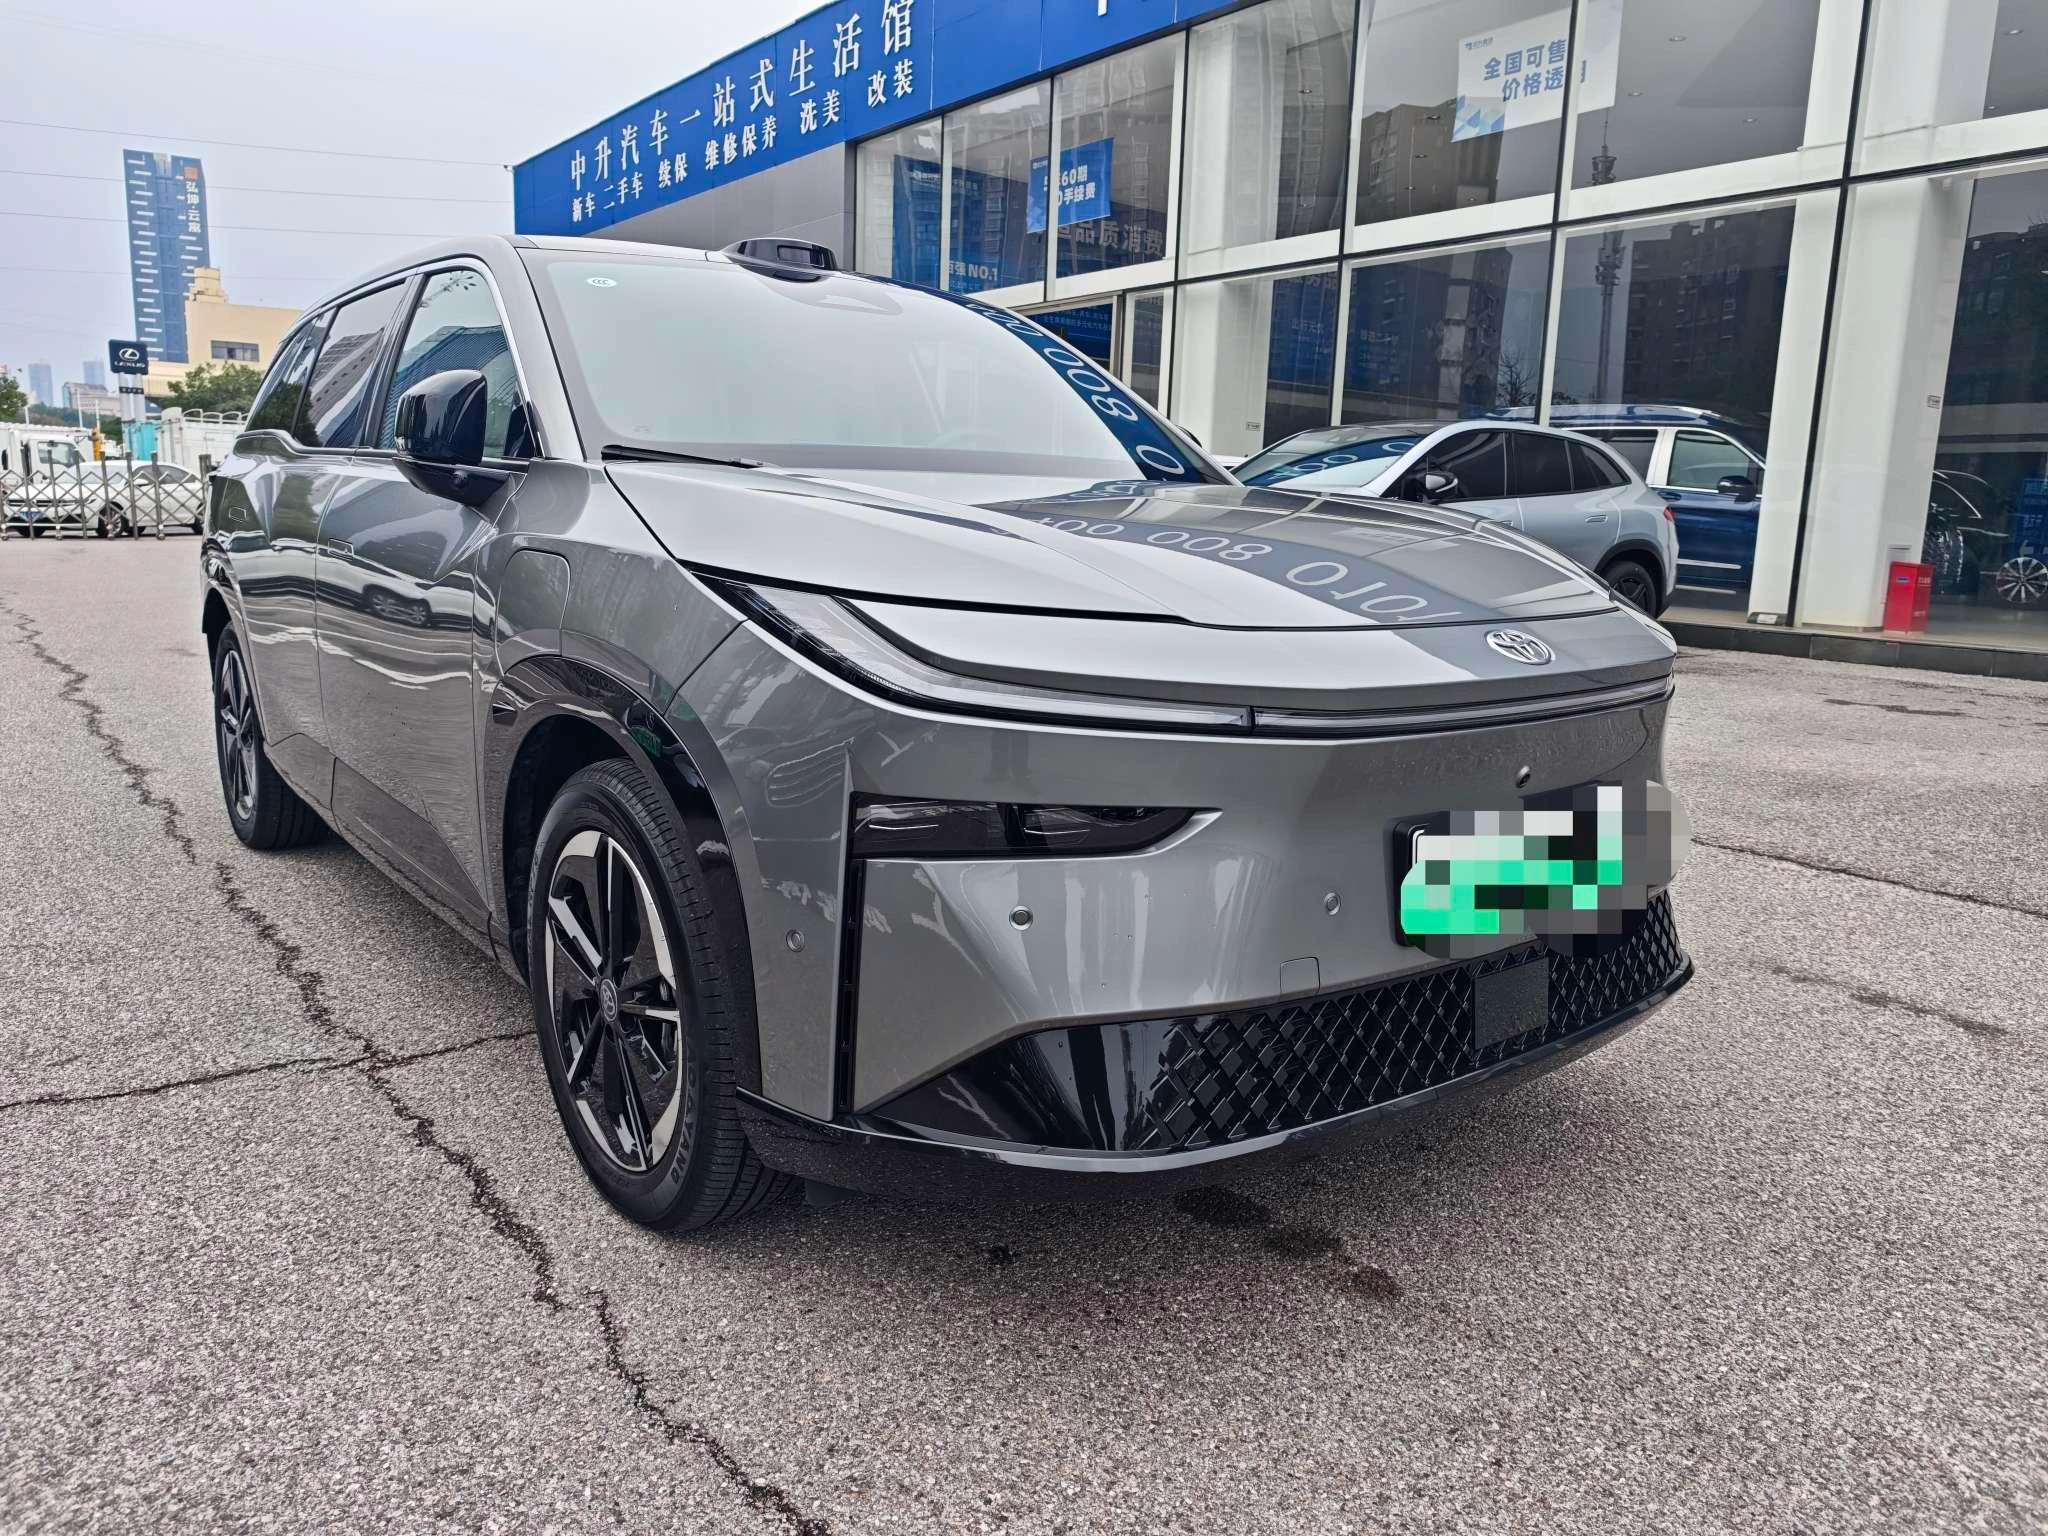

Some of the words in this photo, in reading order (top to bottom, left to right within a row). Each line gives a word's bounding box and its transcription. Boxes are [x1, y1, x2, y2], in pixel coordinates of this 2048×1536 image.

[571, 0, 915, 191] 中升汽车一站式生活馆
[572, 191, 596, 223] 新车
[603, 171, 644, 210] 二手车
[658, 152, 689, 189] 续保
[704, 114, 778, 171] 维修保养
[799, 88, 841, 135] 洗美
[867, 58, 915, 109] 改装
[1483, 38, 1567, 81] 全国可售
